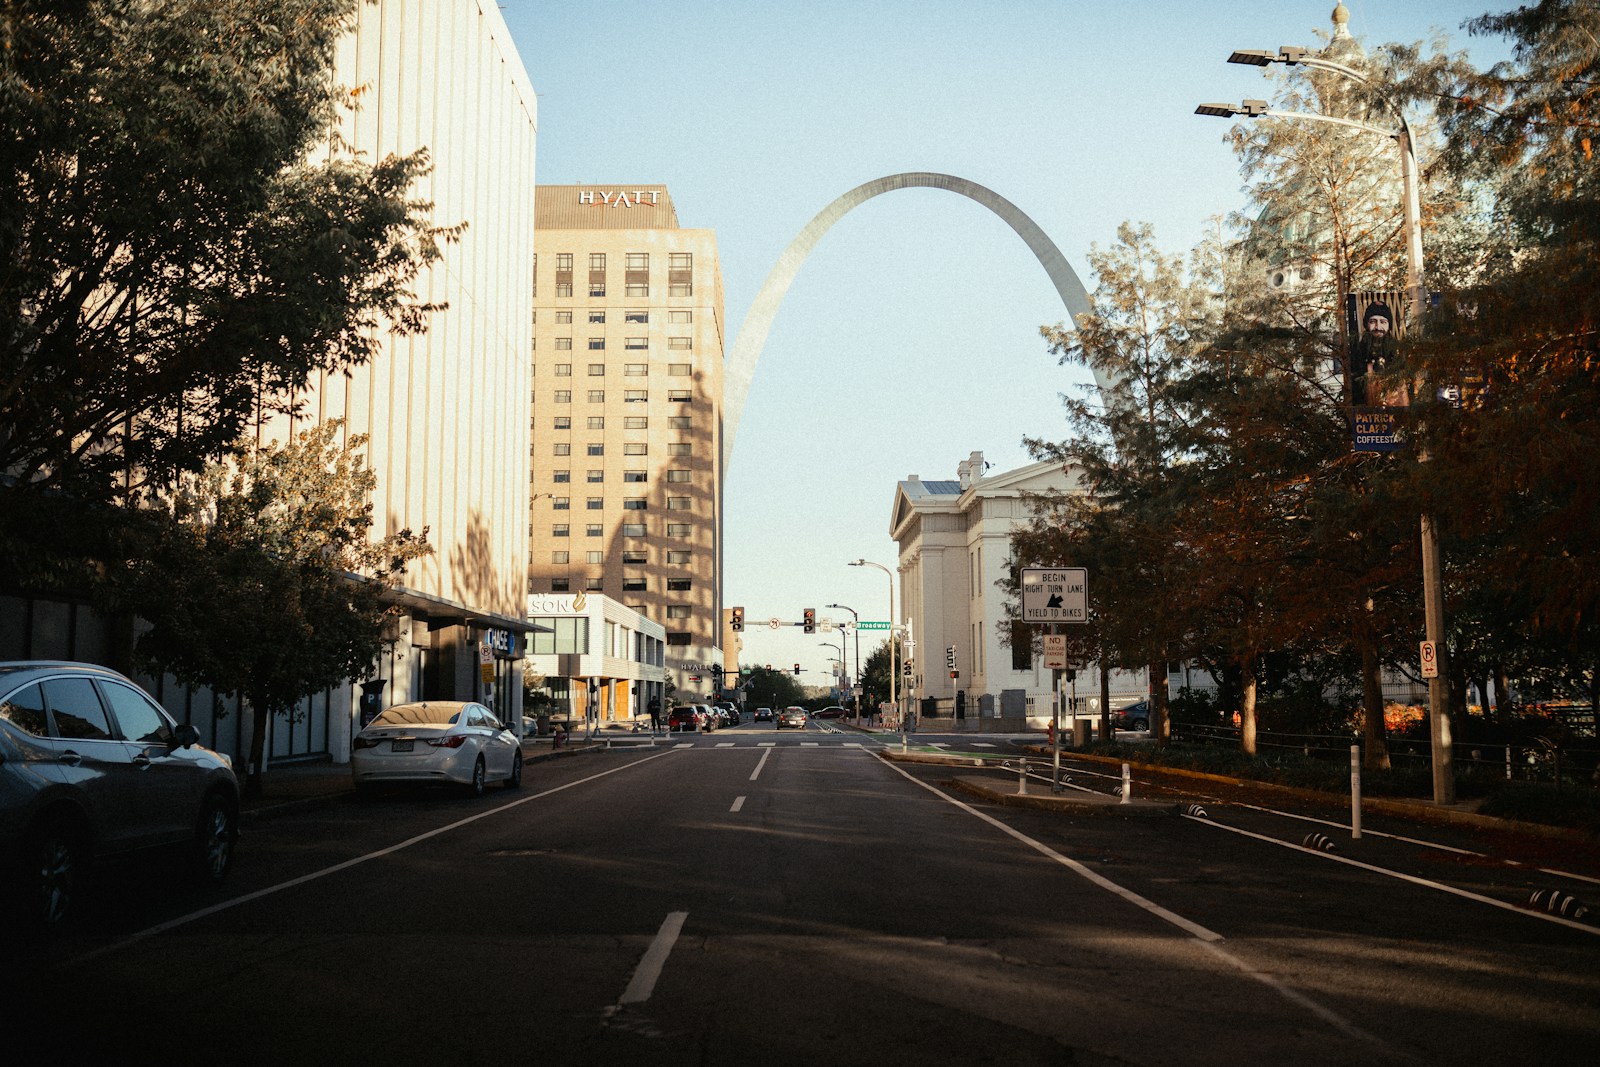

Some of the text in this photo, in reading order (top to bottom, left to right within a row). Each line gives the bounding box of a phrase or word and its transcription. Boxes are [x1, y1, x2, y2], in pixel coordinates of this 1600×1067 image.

[579, 191, 661, 208] HYATT
[1355, 414, 1395, 423] PATRICK
[1355, 424, 1388, 434] CLAPP
[1042, 573, 1066, 582] BEGIN
[1025, 585, 1084, 593] RIGHT TURN LANE
[529, 599, 569, 613] SON
[1028, 608, 1082, 618] YIELD TO BIKES
[857, 622, 891, 630] Broadway
[367, 693, 375, 704] P
